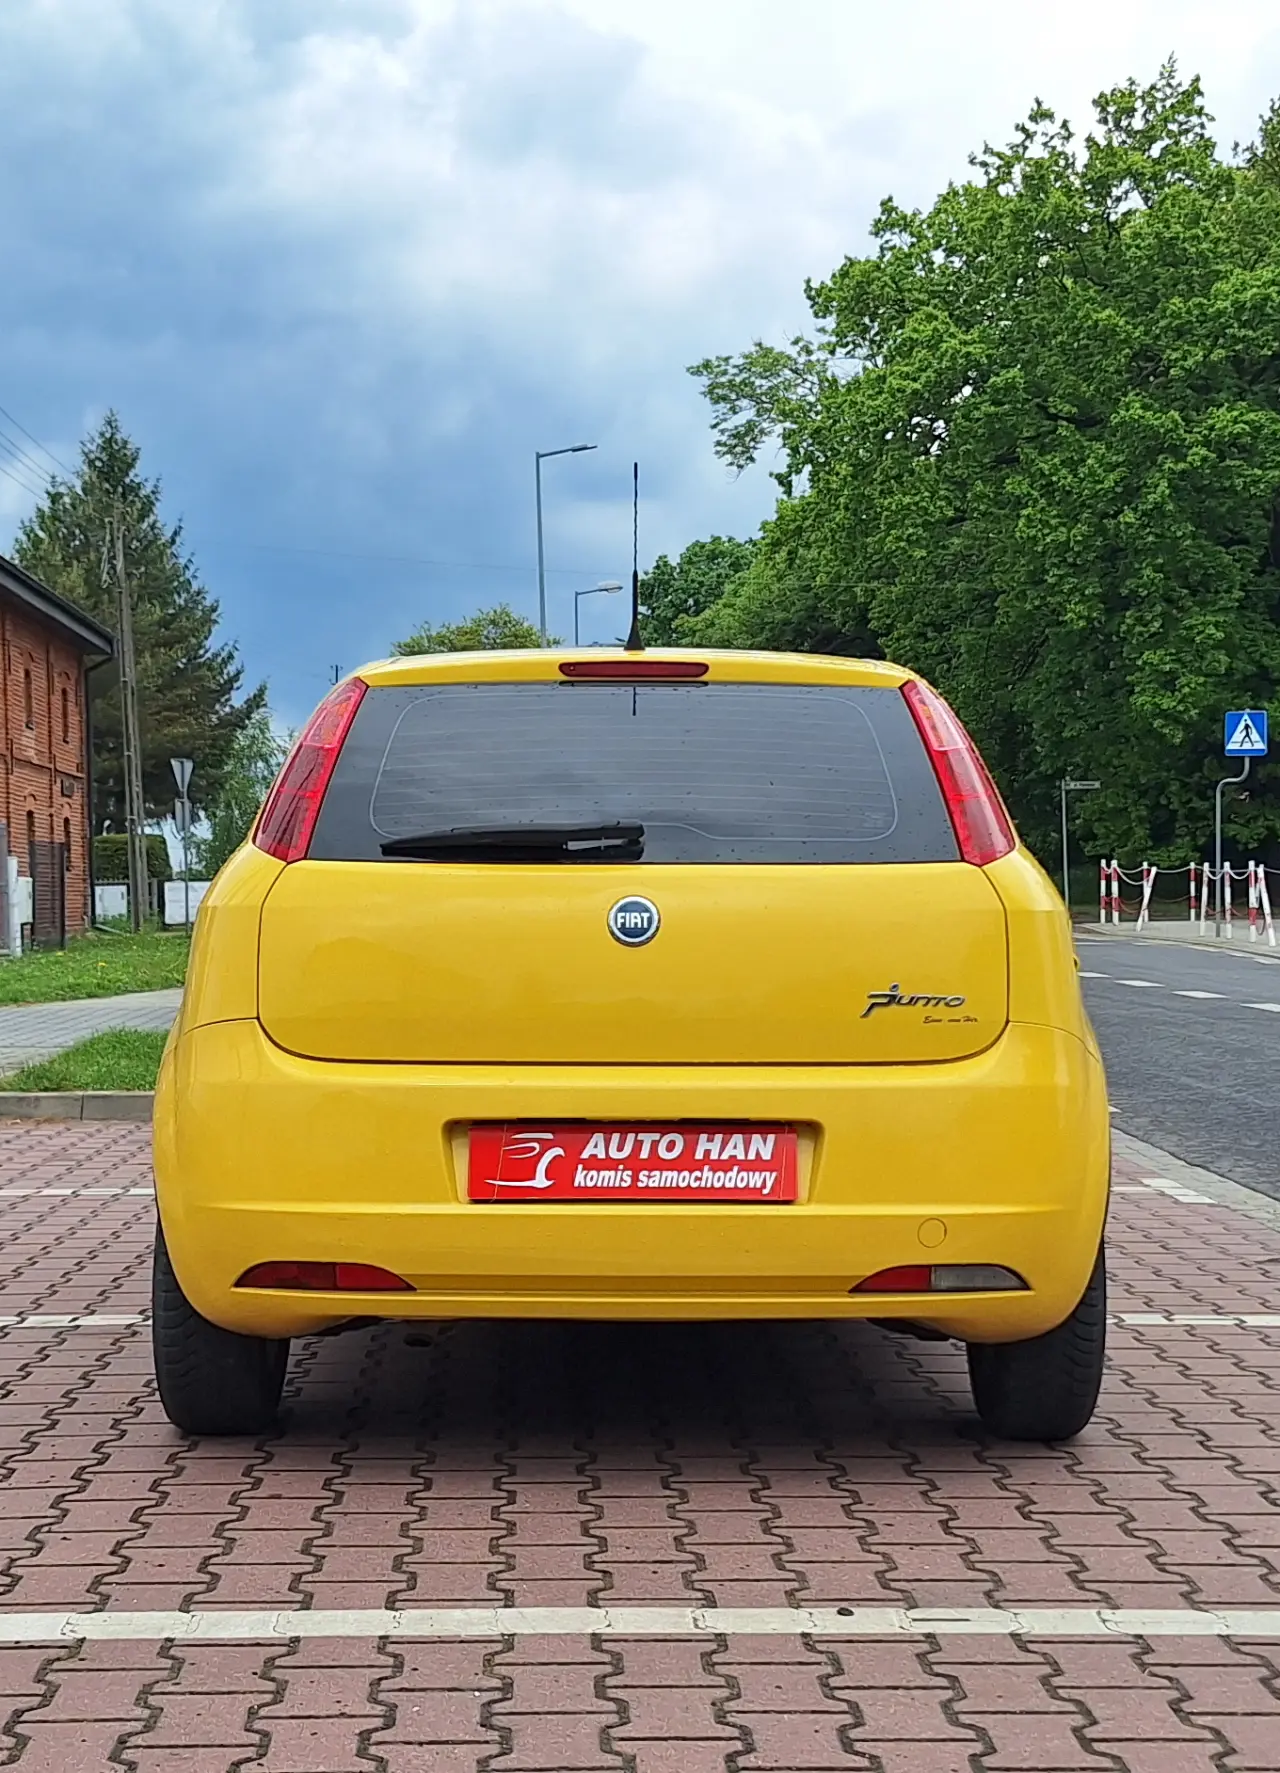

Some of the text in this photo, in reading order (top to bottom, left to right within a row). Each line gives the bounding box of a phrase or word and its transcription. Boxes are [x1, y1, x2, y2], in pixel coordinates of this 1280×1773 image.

[616, 912, 651, 929] FIAT
[579, 1132, 777, 1161] AUTO HAN
[573, 1164, 778, 1194] komis samochodowy
